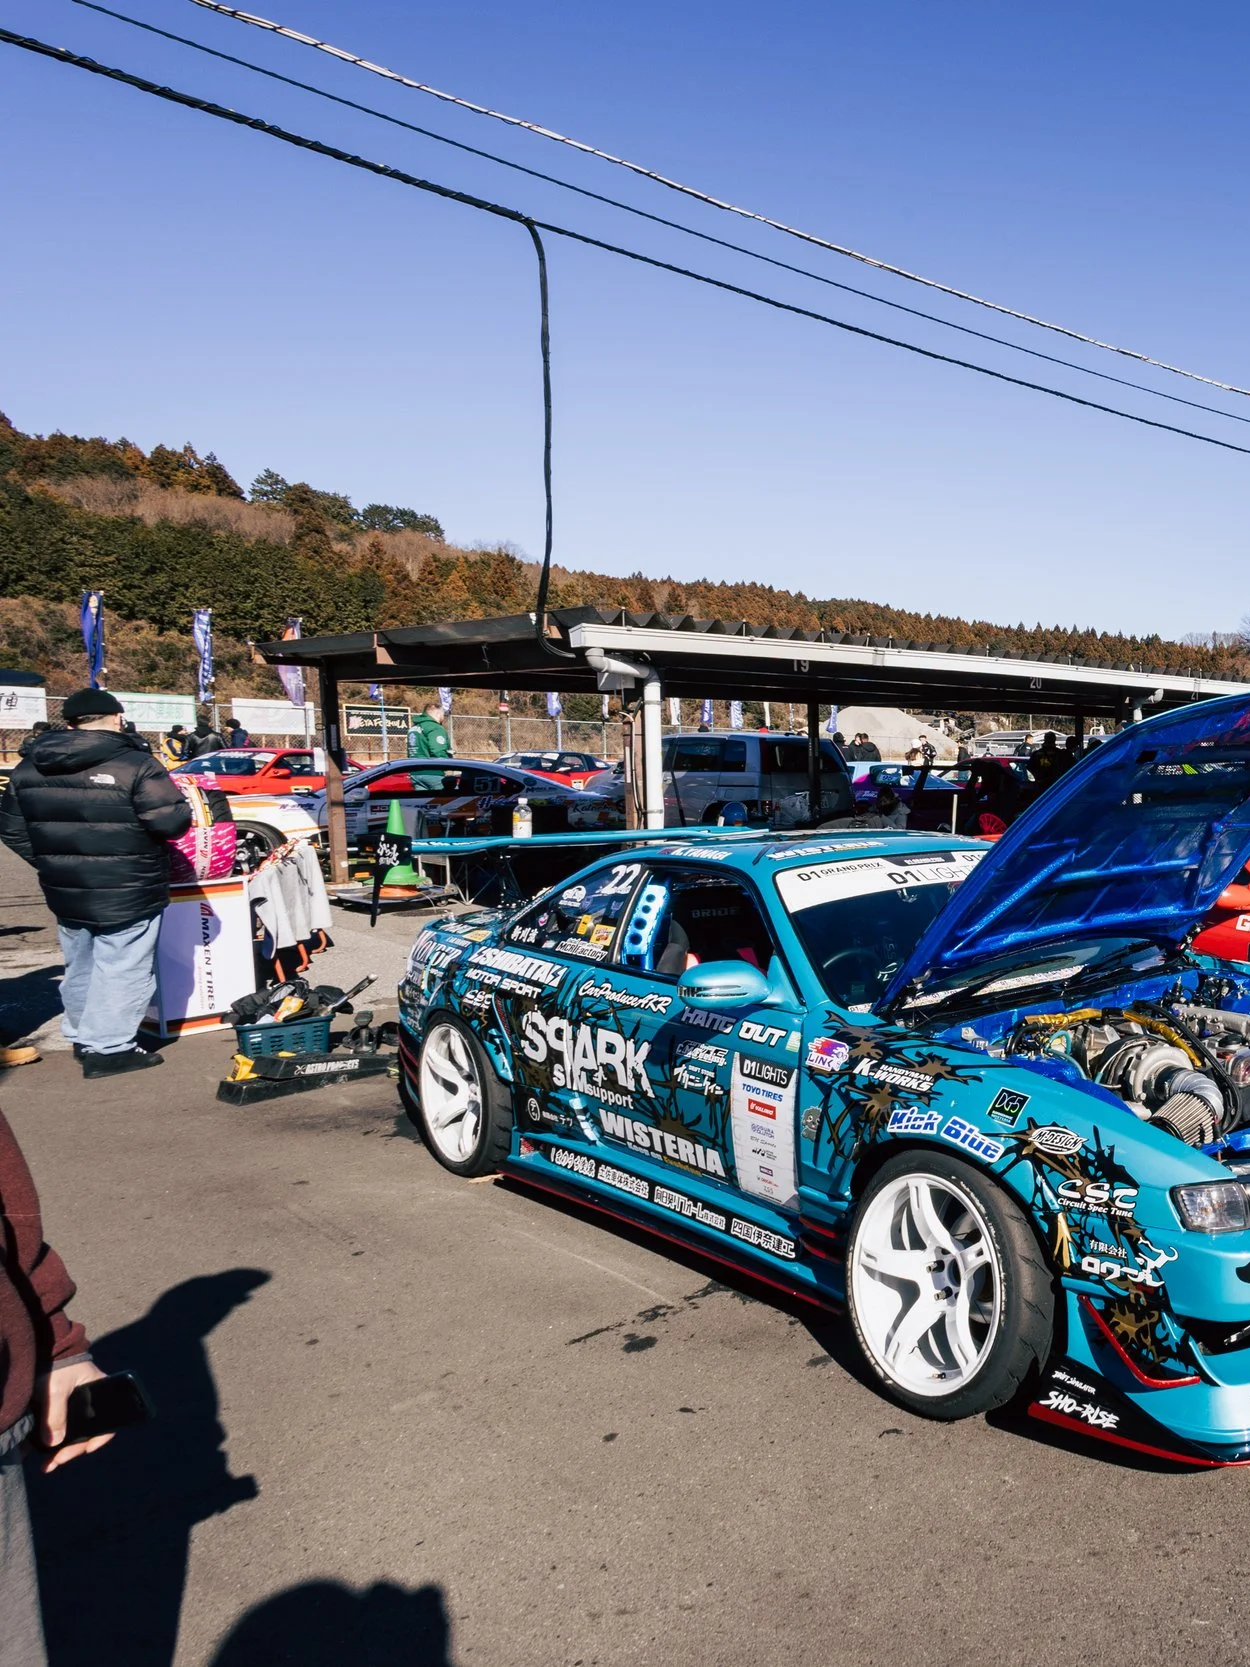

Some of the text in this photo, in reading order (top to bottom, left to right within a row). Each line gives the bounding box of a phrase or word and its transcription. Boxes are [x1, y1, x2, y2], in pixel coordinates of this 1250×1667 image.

[1030, 677, 1042, 689] 20
[858, 861, 883, 870] PRIX
[601, 863, 641, 895] 22
[692, 906, 740, 918] BRIDE
[201, 917, 216, 1010] MAXEN TIRES
[465, 968, 501, 988] MOTOR
[501, 977, 542, 999] SPORT
[681, 1006, 788, 1047] HANG OUT
[852, 1057, 934, 1092] K-WORKS
[879, 1064, 933, 1082] HANDYMAN
[742, 1083, 783, 1102] TOYO TIRES
[995, 1092, 1023, 1113] DG5
[600, 1109, 726, 1178] WISTERIA
[942, 1116, 1004, 1162] Blue
[1033, 1130, 1080, 1148] M-DESIGN
[1057, 1197, 1133, 1218] Circuit Spec Tune
[1089, 1239, 1127, 1259] 有限会社
[1039, 1390, 1121, 1429] SHO-RISE
